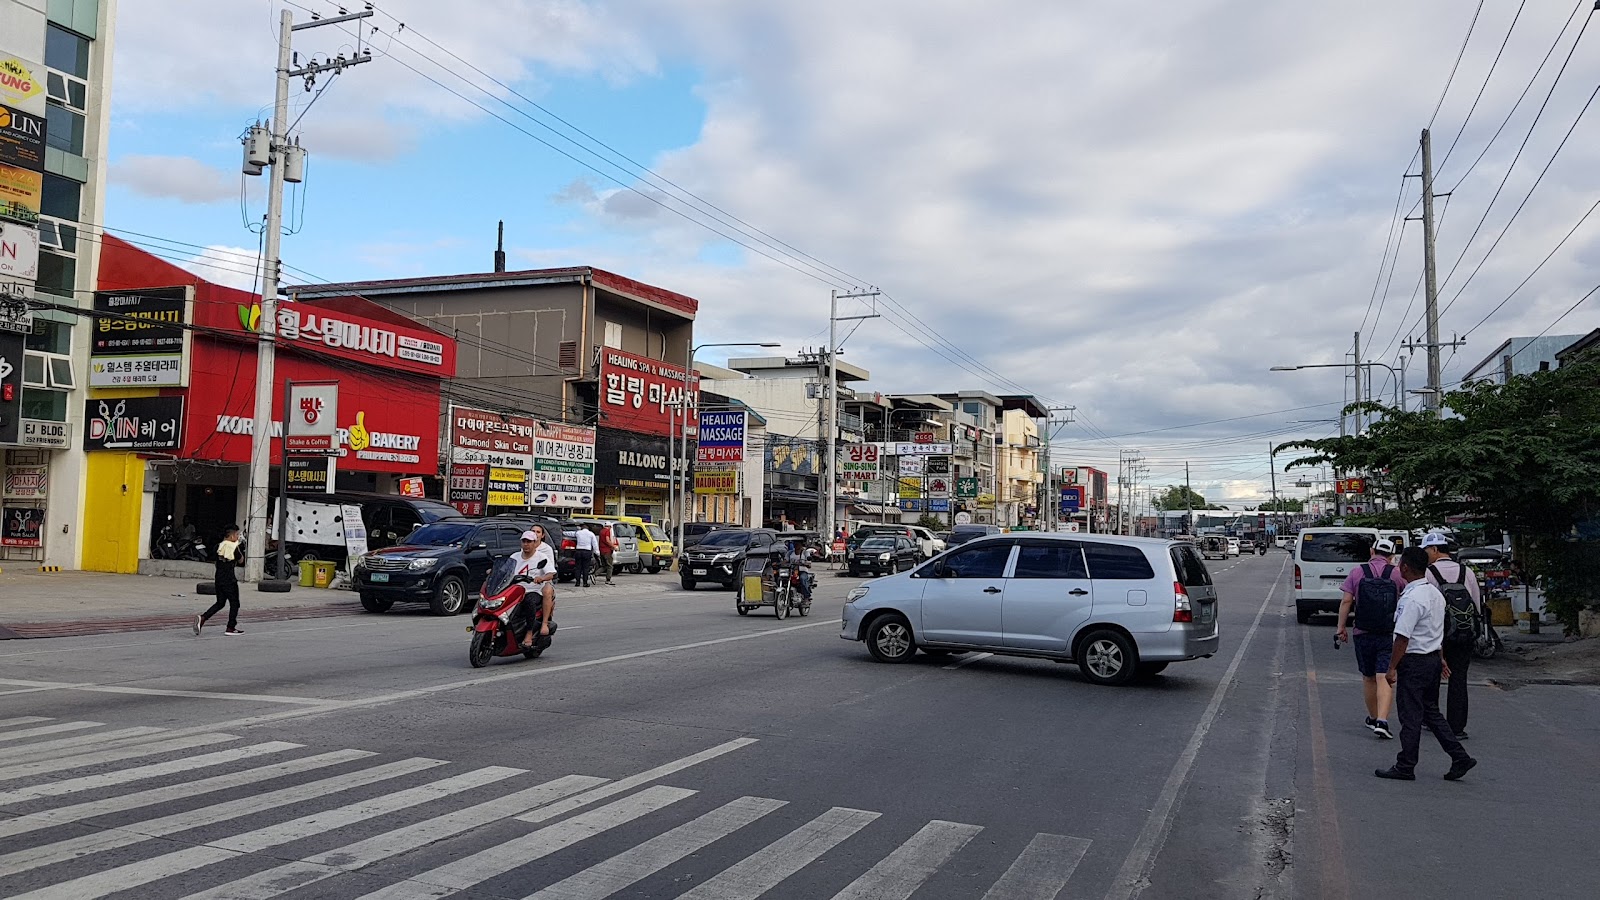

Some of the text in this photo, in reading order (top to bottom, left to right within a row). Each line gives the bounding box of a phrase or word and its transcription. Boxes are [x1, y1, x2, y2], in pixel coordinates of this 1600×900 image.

[277, 307, 395, 357] 힐스템마사지
[107, 360, 178, 373] 힐스템 주열테라피
[608, 353, 638, 370] HEALING
[639, 361, 650, 373] SPA
[651, 365, 657, 375] &
[658, 367, 686, 381] MASSAGE
[606, 373, 698, 420] 힐링 마사지
[216, 415, 283, 438] KORAN
[701, 415, 743, 425] HEALING
[25, 423, 66, 437] EJ BLDG.
[90, 417, 139, 441] DAIN
[457, 417, 533, 438] 다이아몬드스킨케어
[701, 428, 742, 441] MASSAGE
[36, 437, 65, 445] FRIENDSHIP
[289, 438, 305, 446] Shake
[311, 438, 328, 446] Coffee
[370, 431, 420, 450] BAKERY
[459, 435, 529, 452] Diamond Skin Care
[357, 451, 399, 462] PHILIPPINES
[398, 453, 419, 463] BREAD
[536, 440, 593, 460] 에어컨/냉장고
[849, 446, 877, 462] 싱싱
[464, 452, 478, 462] Spa
[487, 454, 504, 466] Body
[505, 456, 524, 466] Salon
[618, 450, 666, 470] HALONG
[466, 467, 475, 475] Skin
[14, 476, 38, 486] 마사지
[695, 477, 720, 488] HALONG
[721, 476, 734, 487] BAY
[451, 491, 482, 500] COSMETIC
